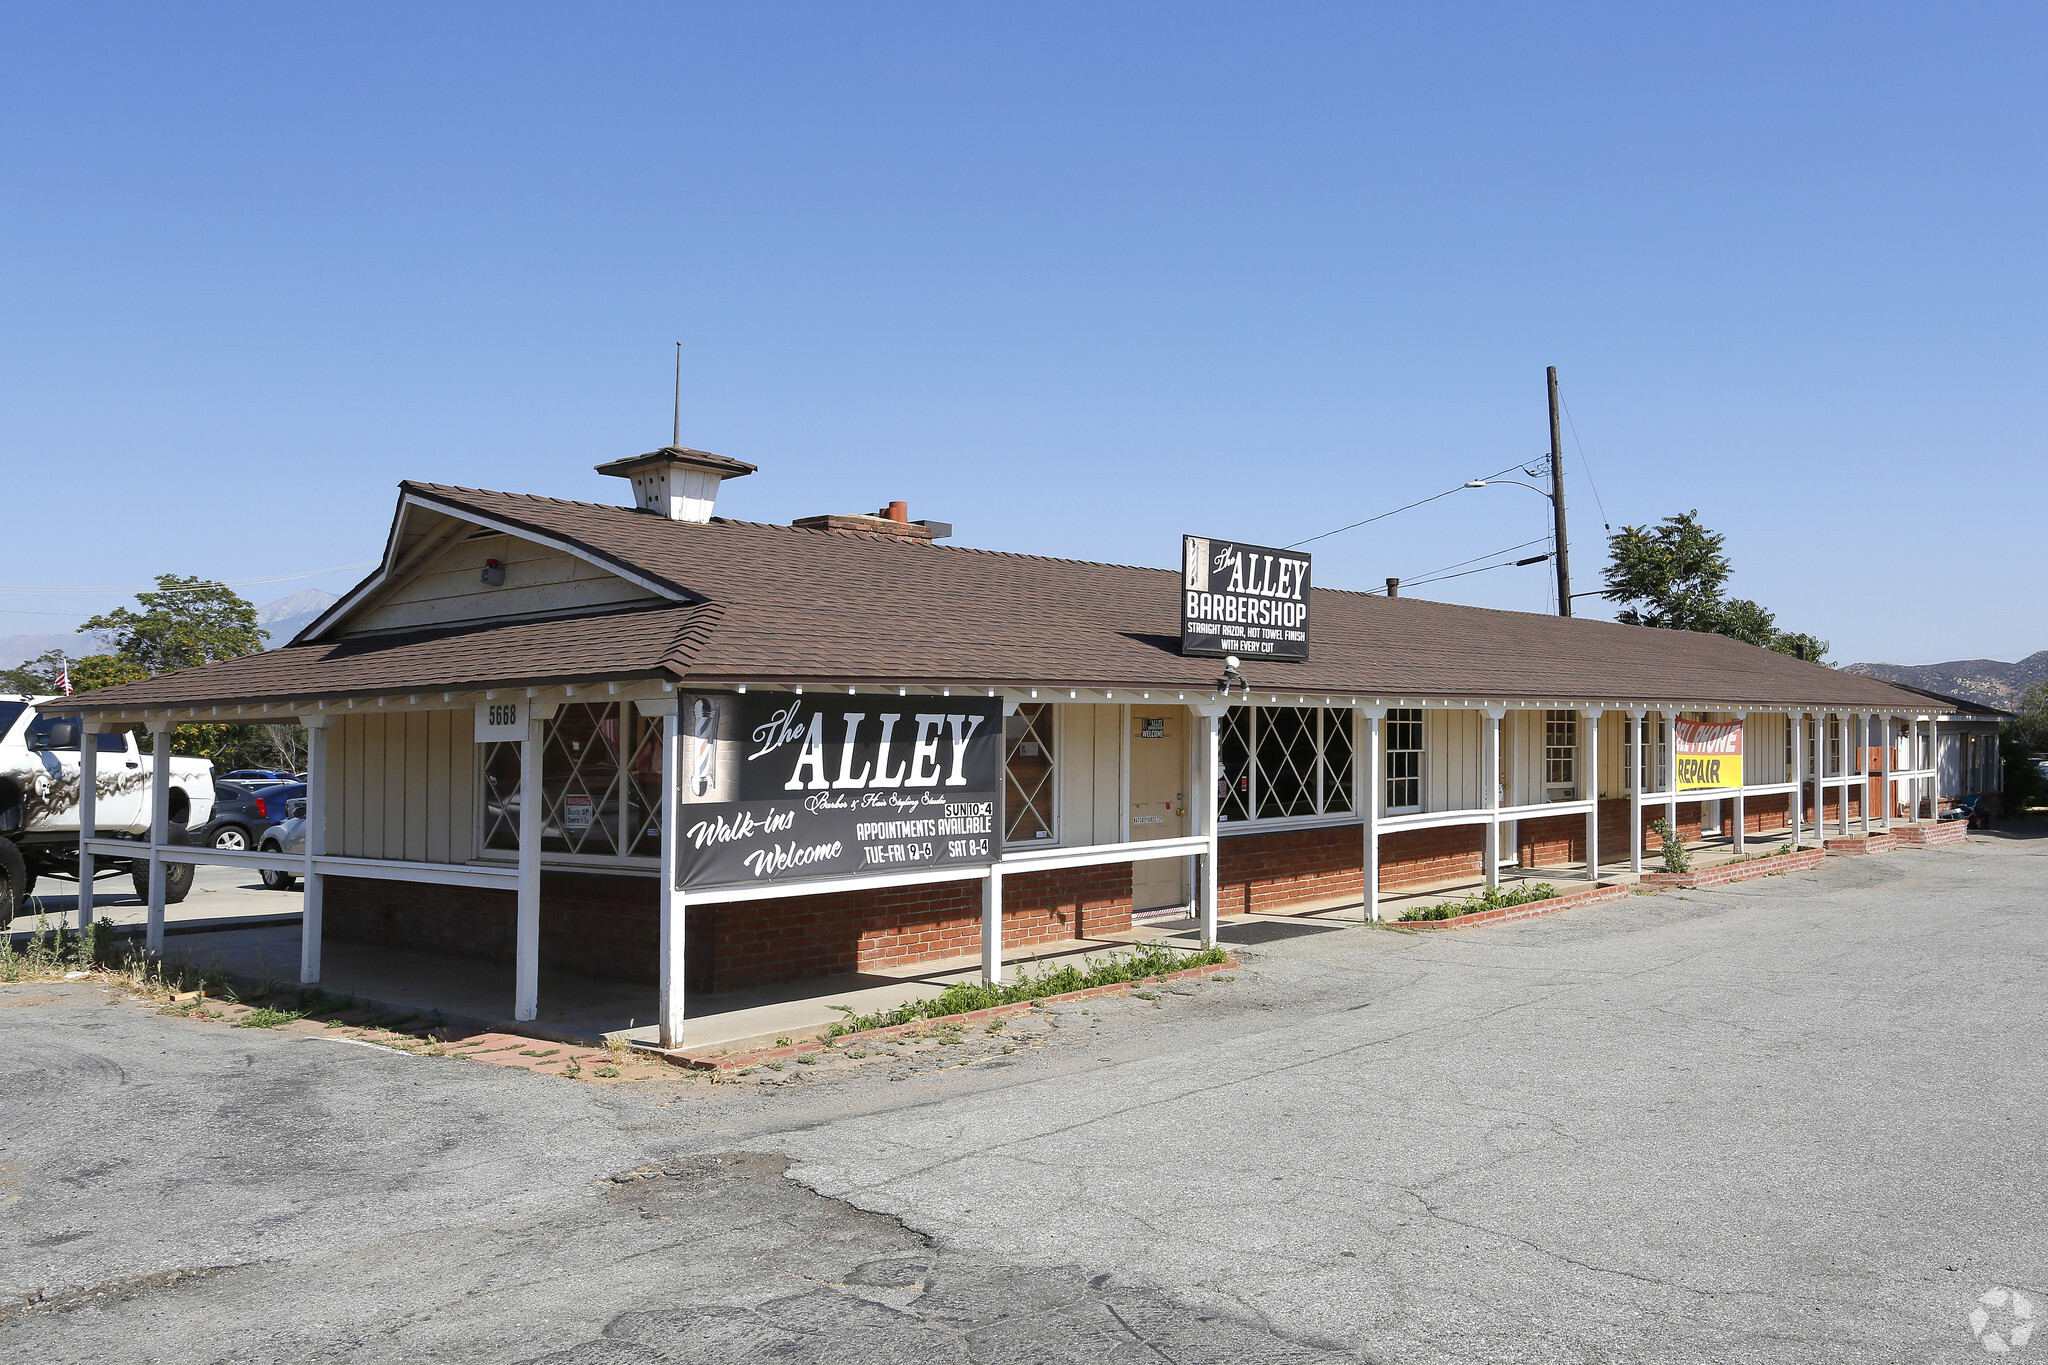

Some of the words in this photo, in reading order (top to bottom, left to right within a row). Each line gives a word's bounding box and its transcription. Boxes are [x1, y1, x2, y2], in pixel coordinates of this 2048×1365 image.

[1213, 544, 1236, 574] The
[1226, 551, 1309, 600] ALLEY
[1187, 591, 1307, 628] BARBERSHOP
[1187, 622, 1221, 635] STRAIGHT
[1222, 626, 1246, 639] RAZOR,
[1247, 627, 1260, 639] HOT
[1261, 628, 1283, 641] TOWEL
[1284, 631, 1305, 642] FINISH
[1221, 639, 1239, 651] WITH
[1240, 640, 1260, 652] EVERY
[1261, 643, 1274, 653] CUT
[489, 704, 516, 725] 5668
[748, 699, 805, 761] The
[784, 711, 985, 790] ALLEY
[1142, 730, 1164, 738] WELCOME
[1691, 724, 1741, 753] PHONE
[1678, 759, 1720, 783] REPAIR
[804, 791, 847, 815] Barber
[850, 799, 859, 811] &
[861, 792, 887, 808] Hair
[888, 792, 919, 814] Styling
[921, 791, 946, 805] Studio
[946, 803, 967, 816] SUN
[968, 803, 992, 816] 10-4
[686, 802, 795, 849] Walk-ins
[857, 820, 935, 841] APPOINTMENTS
[938, 817, 992, 836] AVAILABLE
[743, 840, 843, 877] Welcome
[864, 844, 906, 864] TUE-FRI
[948, 840, 967, 858] SAT
[969, 839, 988, 857] 8-4
